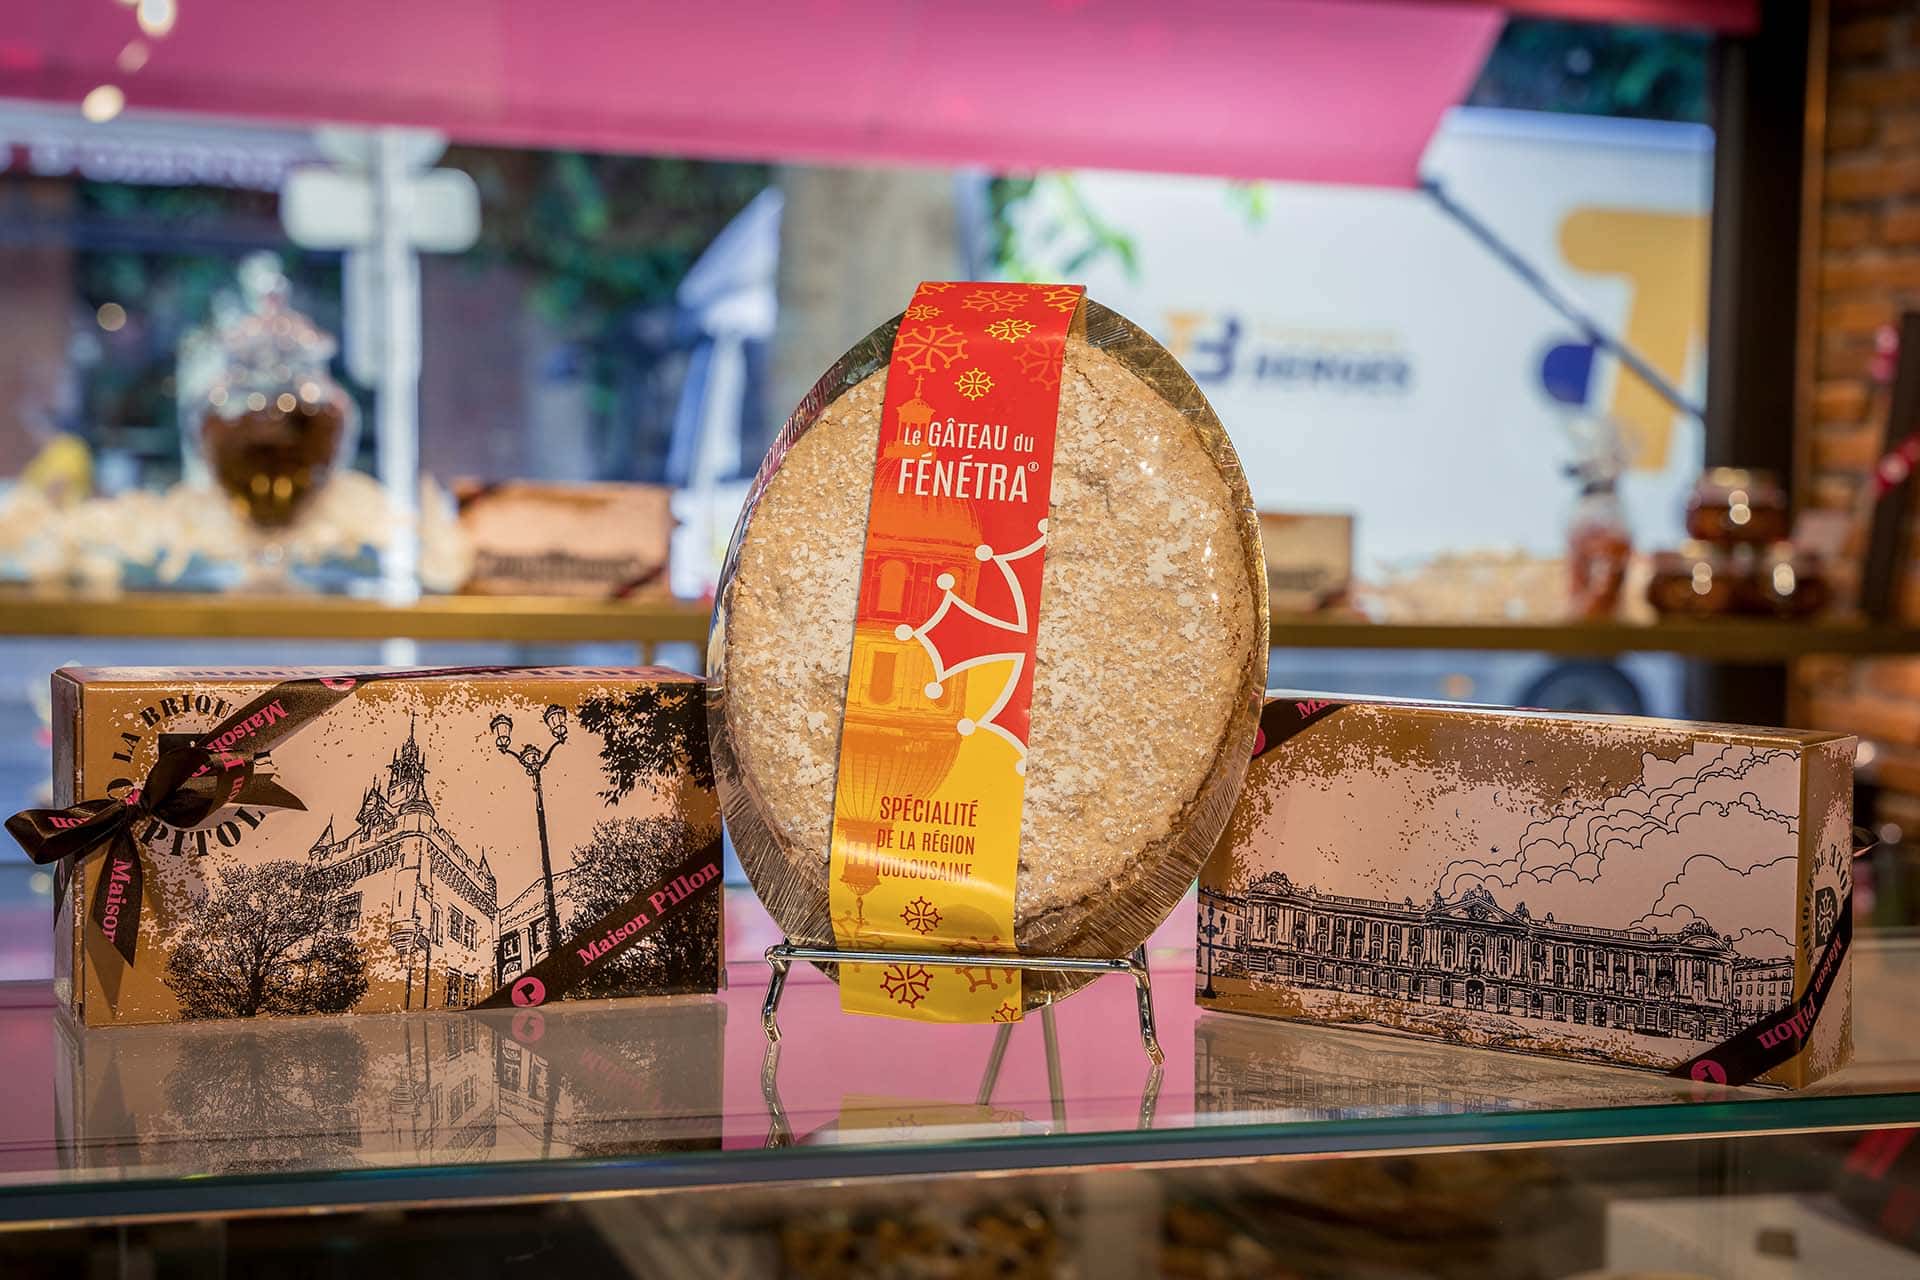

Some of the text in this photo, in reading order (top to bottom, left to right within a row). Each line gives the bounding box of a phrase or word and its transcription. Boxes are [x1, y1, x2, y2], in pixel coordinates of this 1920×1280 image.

[904, 418, 1034, 452] Le GÂTEAU du
[112, 732, 141, 763] LA
[140, 695, 233, 728] BRIQU
[880, 794, 978, 827] SPÉCIALITÉ
[876, 828, 975, 856] DE LA RÉGION
[876, 857, 973, 882] TOULOUSAINE
[576, 863, 720, 967] Maison Pillon
[1756, 991, 1817, 1049] Pillon
